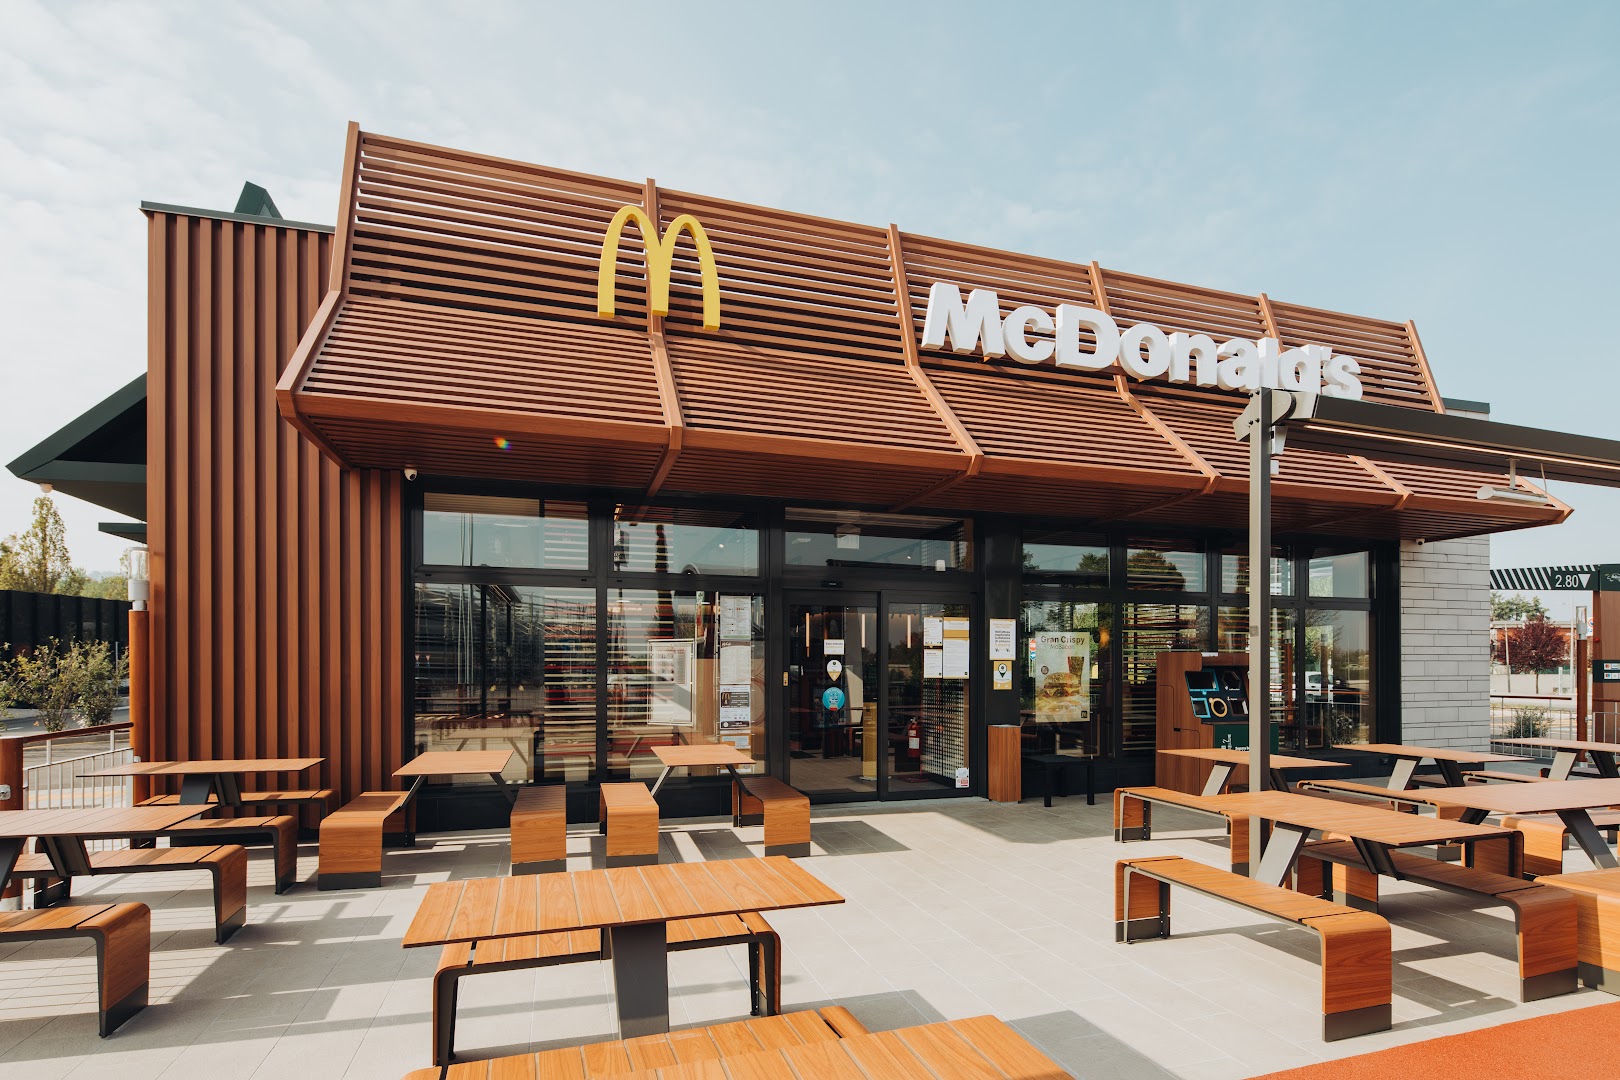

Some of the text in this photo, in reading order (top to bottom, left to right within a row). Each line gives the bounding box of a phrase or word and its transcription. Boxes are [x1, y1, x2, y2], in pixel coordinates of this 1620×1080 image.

[921, 282, 1363, 400] McDonald's
[1555, 574, 1579, 588] 2.80
[1040, 635, 1085, 646] Gran Crispy
